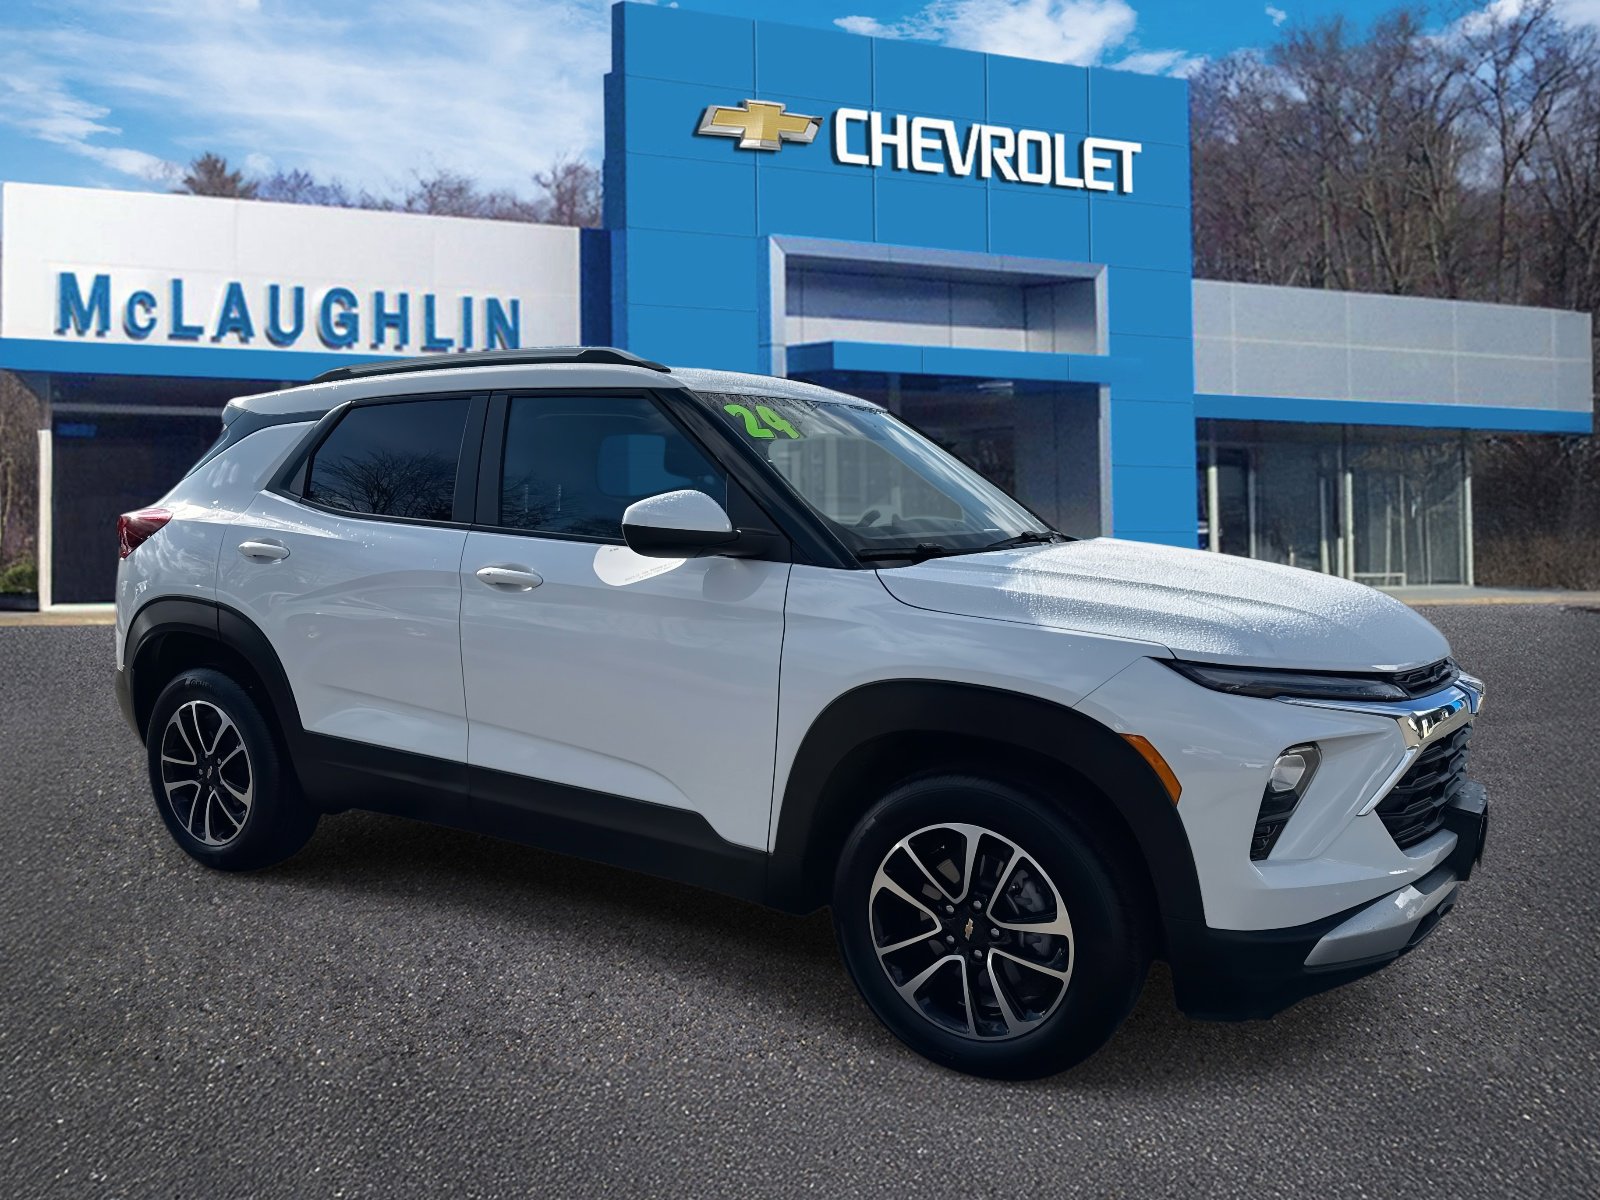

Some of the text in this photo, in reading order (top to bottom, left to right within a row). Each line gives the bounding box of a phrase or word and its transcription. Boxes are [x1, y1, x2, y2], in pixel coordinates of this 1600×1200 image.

[834, 107, 1142, 193] CHEVROLET
[55, 272, 521, 351] McLAUGHLIN
[723, 404, 800, 439] 24
